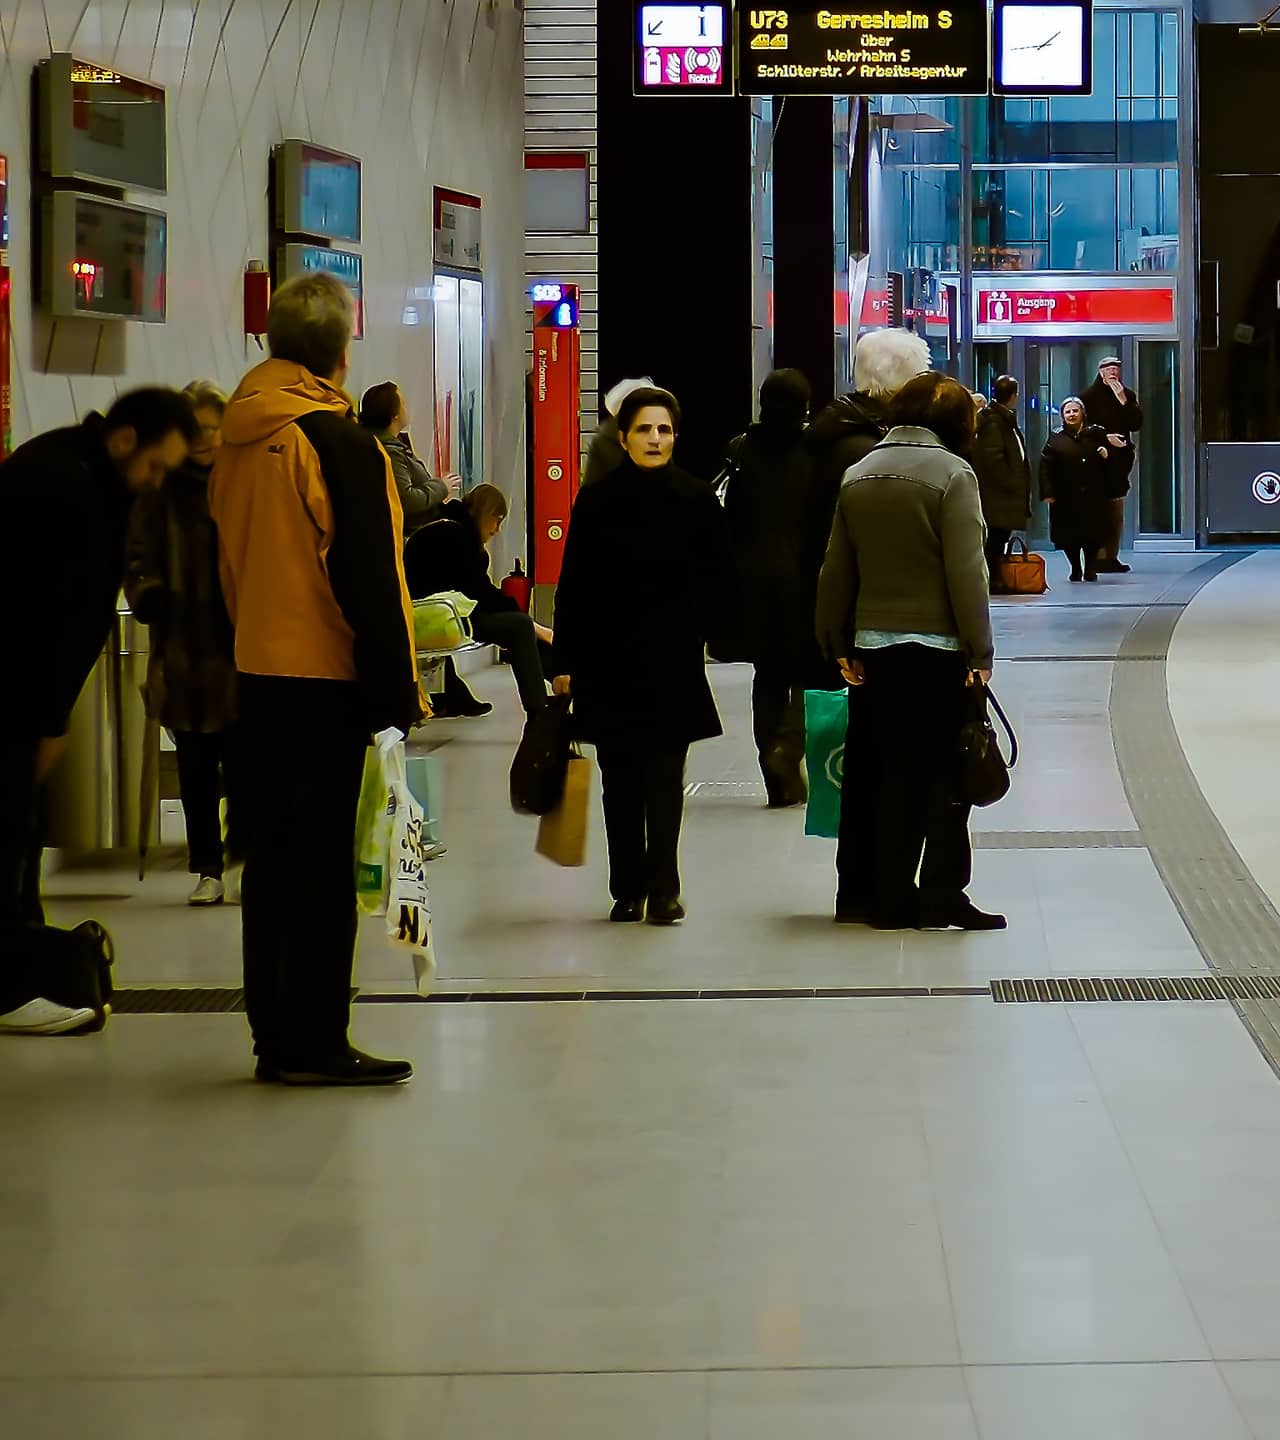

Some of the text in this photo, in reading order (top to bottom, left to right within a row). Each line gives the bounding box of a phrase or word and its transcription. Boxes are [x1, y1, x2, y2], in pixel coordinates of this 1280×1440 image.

[750, 10, 952, 29] U73 Gerresheim S
[860, 33, 894, 47] über
[827, 48, 911, 63] Wehrhahn S
[757, 64, 843, 78] Schlüterstr.
[860, 64, 967, 79] Arbeitsagentur
[1017, 298, 1056, 309] Ausgang
